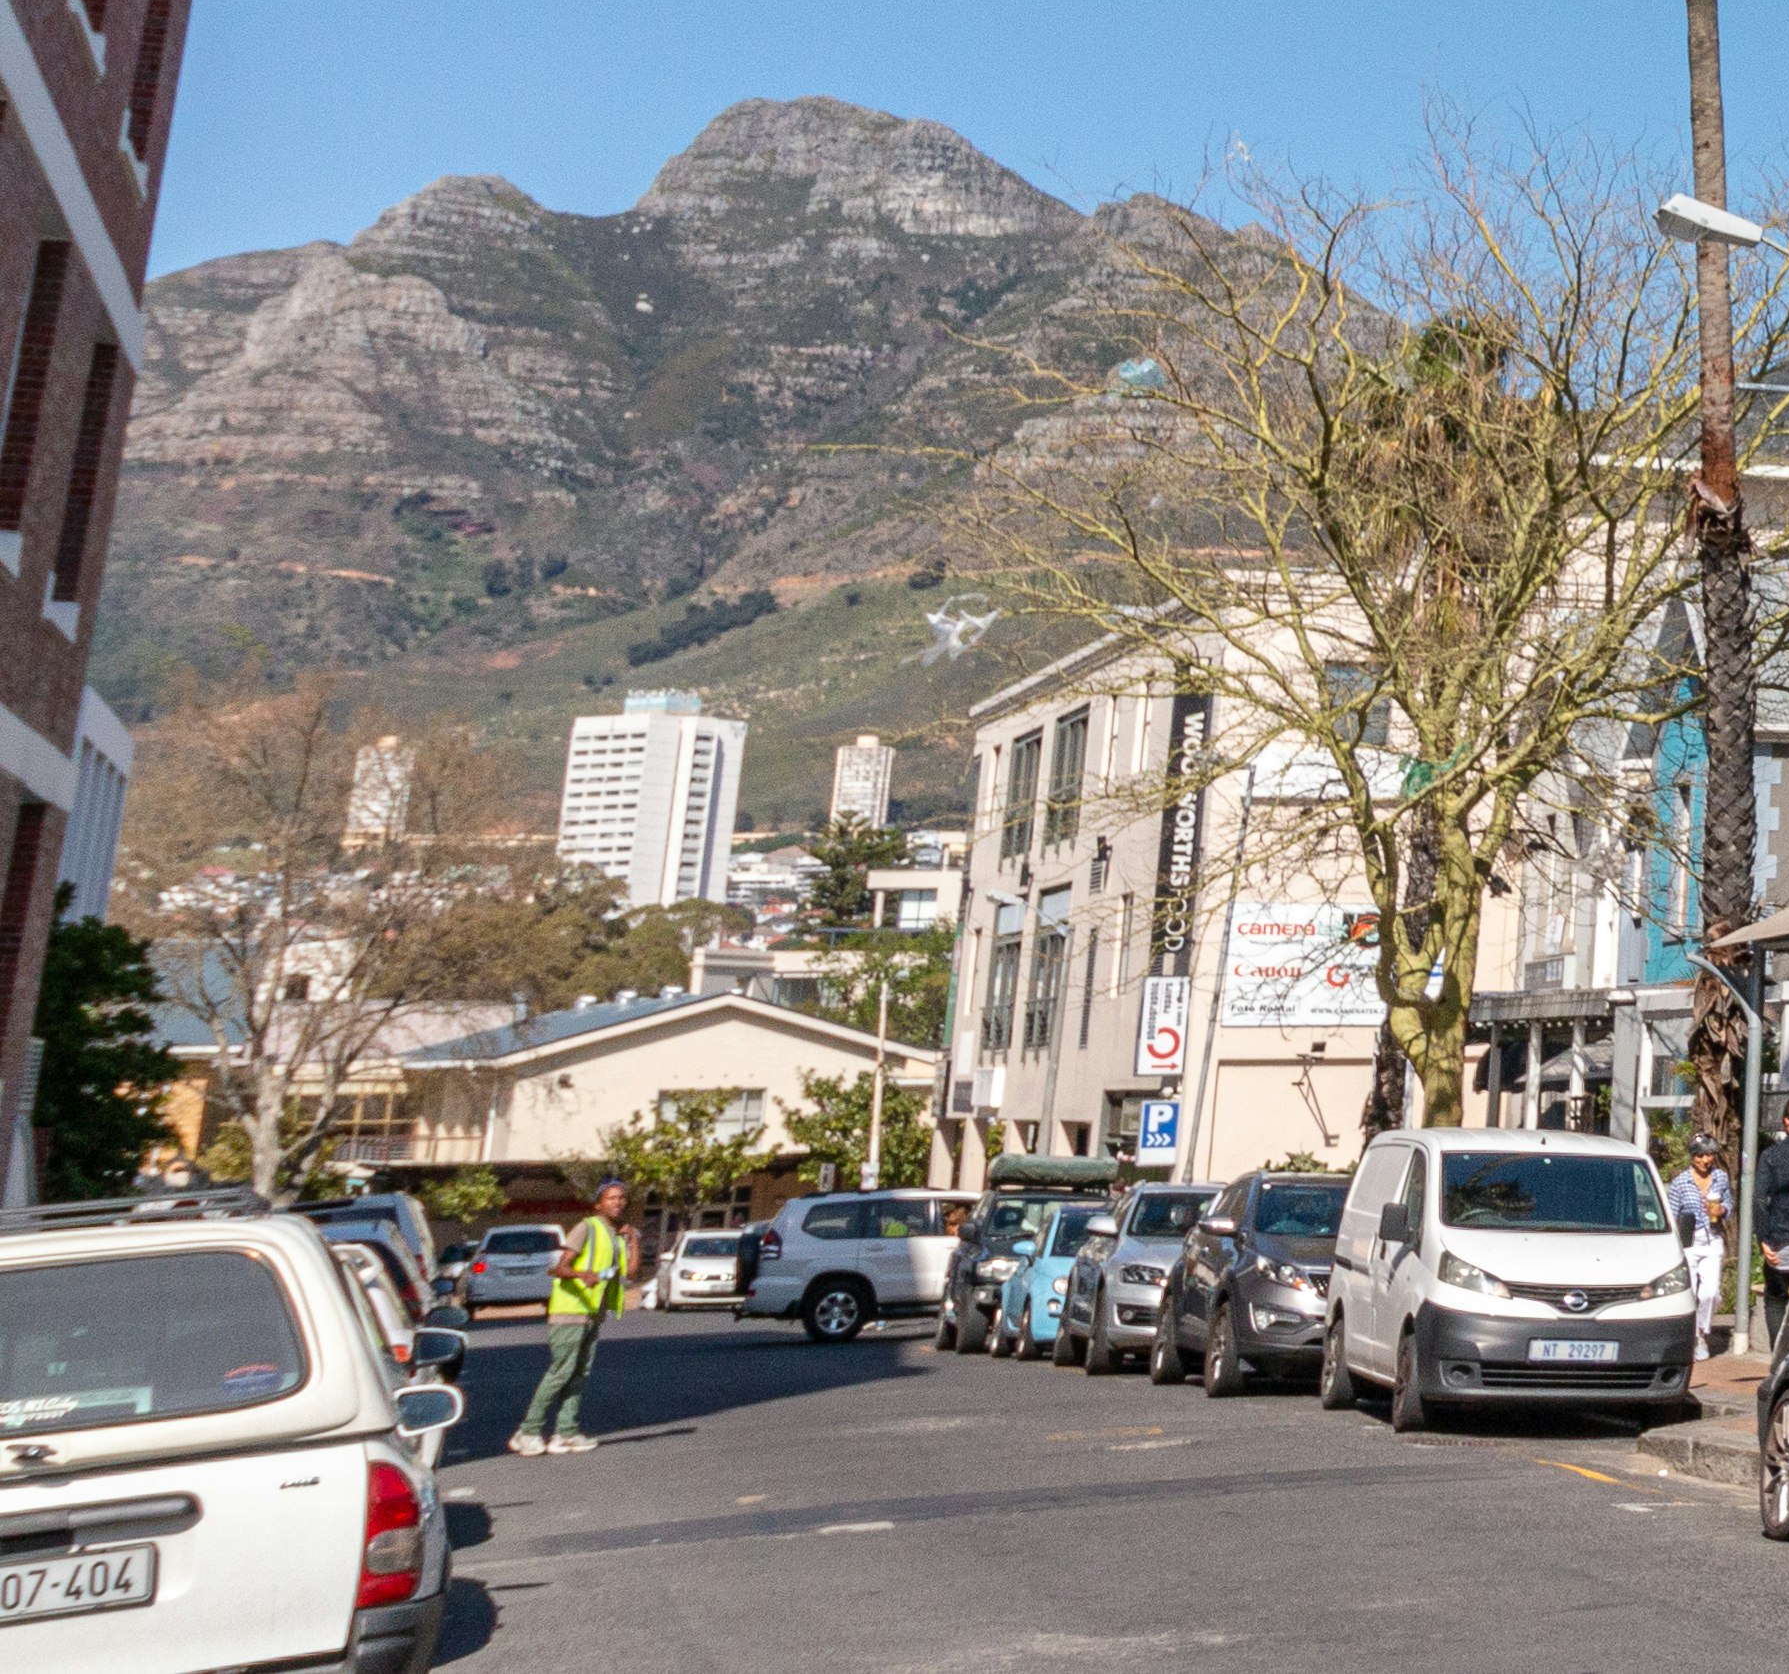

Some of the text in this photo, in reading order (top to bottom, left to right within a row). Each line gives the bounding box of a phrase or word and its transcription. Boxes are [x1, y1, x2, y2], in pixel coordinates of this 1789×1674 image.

[1169, 710, 1206, 888] WOOWORTHS
[1234, 963, 1303, 978] Canon
[1148, 1104, 1174, 1133] P
[1542, 1343, 1606, 1358] NT 29297
[0, 1556, 133, 1610] 07-404
